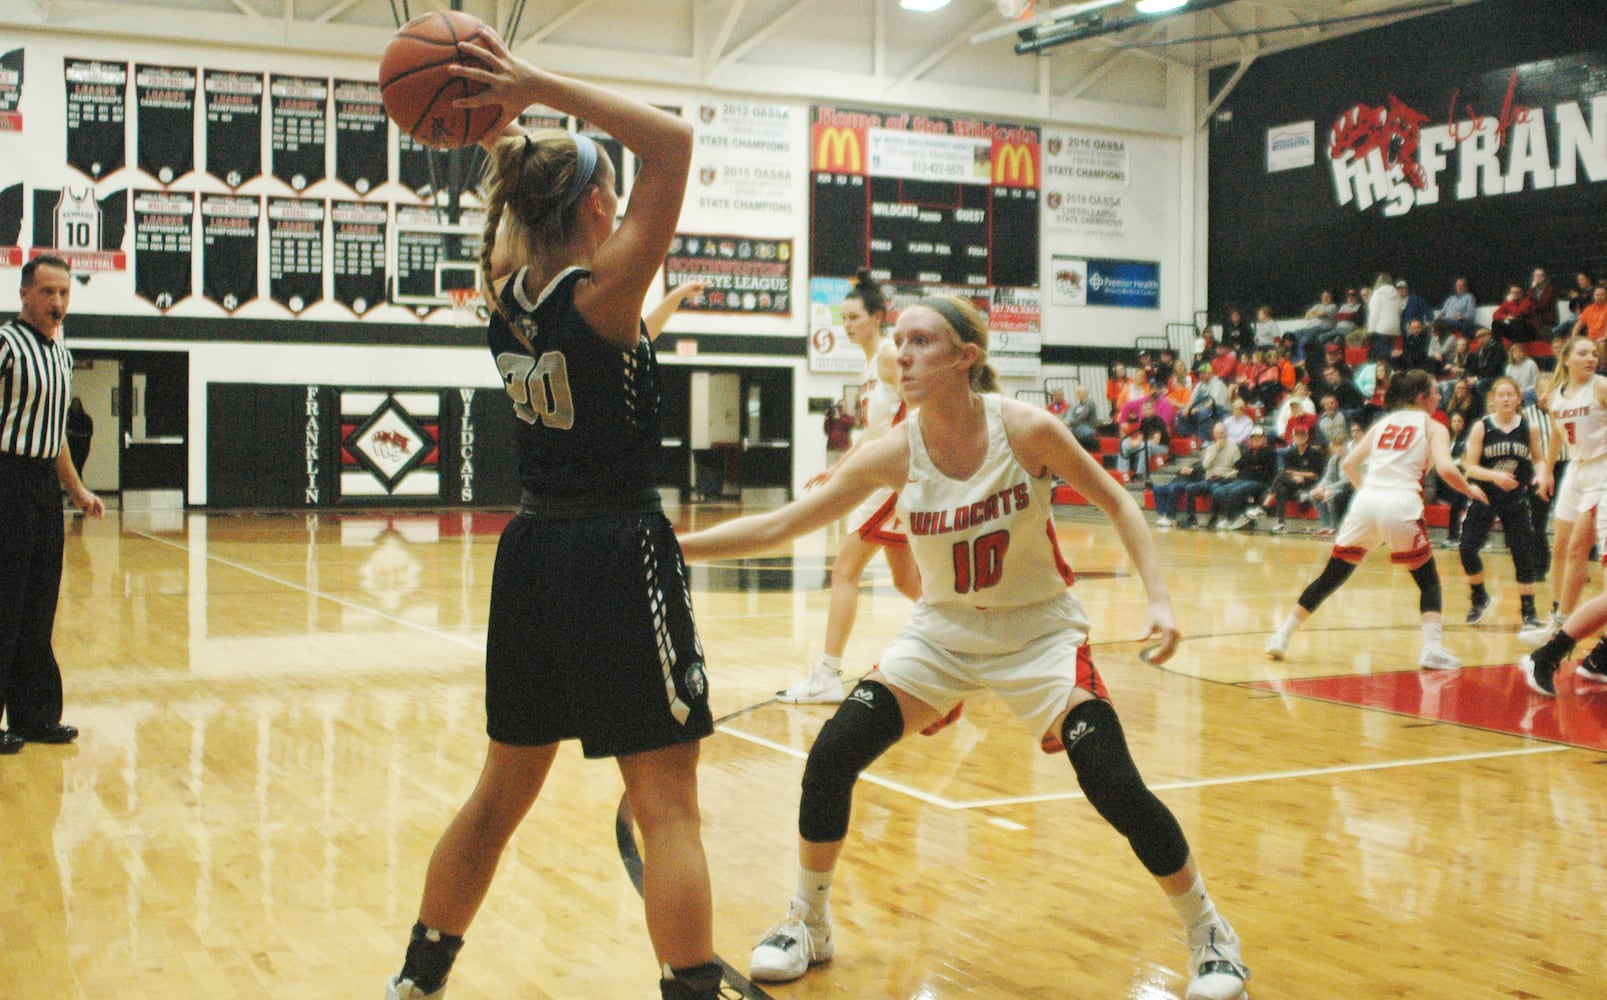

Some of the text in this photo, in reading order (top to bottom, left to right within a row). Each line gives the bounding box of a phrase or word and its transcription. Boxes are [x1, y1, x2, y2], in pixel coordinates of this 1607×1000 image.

[723, 104, 749, 116] 2012
[818, 106, 1038, 145] Home of the Wildcats
[700, 136, 790, 153] STATE CHAMPIONS
[1048, 166, 1126, 182] STATE CHAMPIONS
[1331, 146, 1415, 217] FHS
[700, 198, 792, 214] STATE CHAMPIONS
[872, 202, 919, 218] WILDCATS
[956, 208, 985, 223] GUEST
[66, 222, 90, 247] 10
[668, 272, 788, 291] BUCKEYE LEAGUE
[1104, 277, 1159, 290] Premier Health
[305, 386, 319, 504] FRANKLIN
[459, 388, 475, 502] WILDCATS
[1377, 423, 1417, 451] 20
[910, 482, 1030, 535] WILDCATS
[953, 529, 1010, 594] 10
